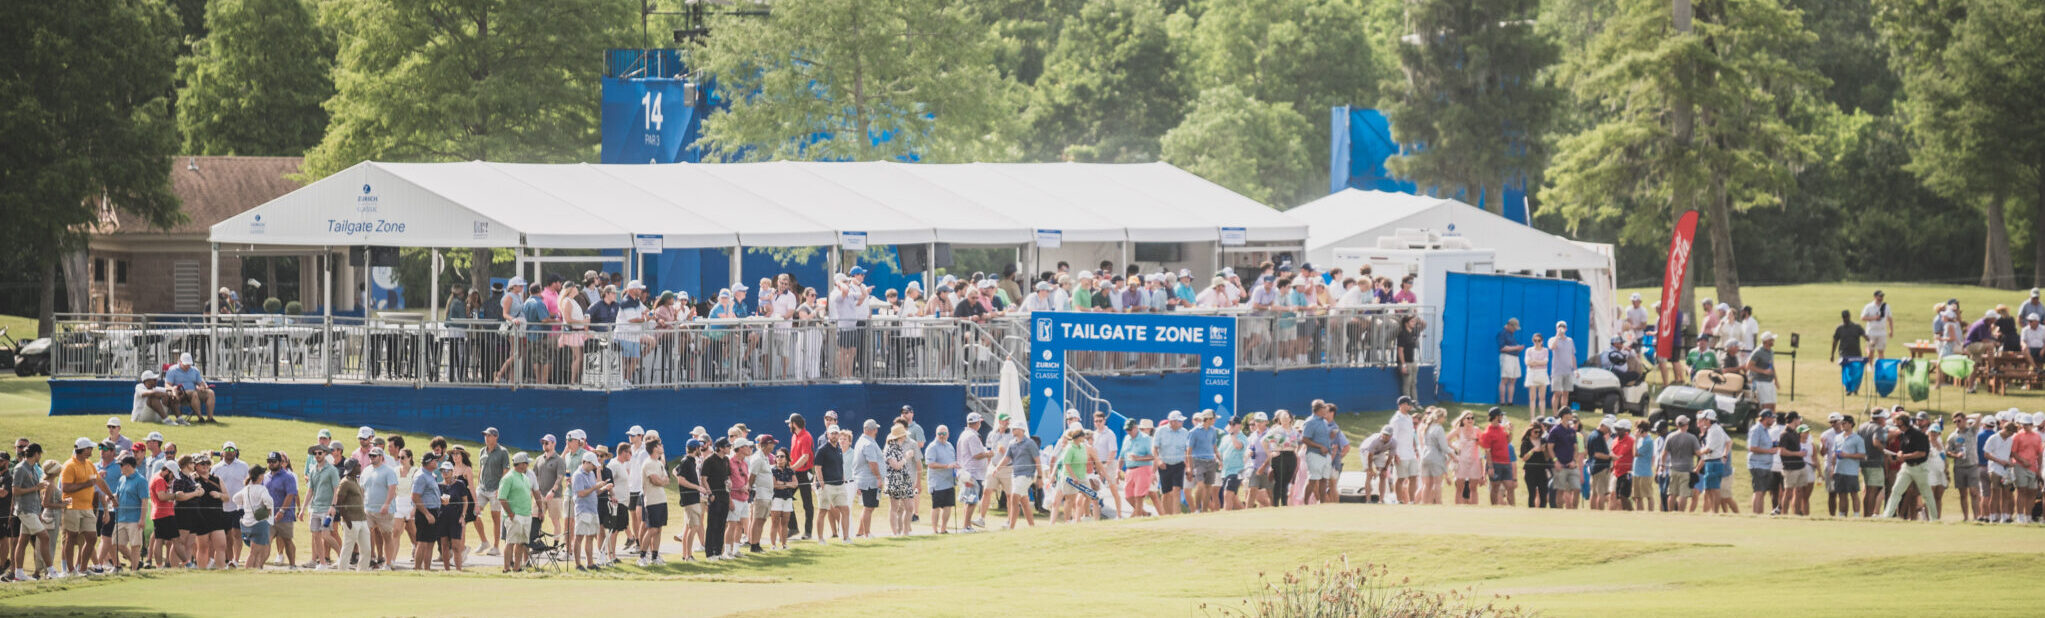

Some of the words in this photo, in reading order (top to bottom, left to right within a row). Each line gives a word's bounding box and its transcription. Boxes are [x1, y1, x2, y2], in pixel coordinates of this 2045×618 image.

[642, 91, 664, 130] 14
[645, 134, 656, 145] PAR
[328, 219, 373, 235] Tailgate
[375, 219, 406, 233] Zone
[1061, 323, 1147, 341] TAILGATE
[1155, 326, 1204, 343] ZONE
[1035, 361, 1060, 369] ZURICH
[1205, 378, 1230, 386] CLASSIC
